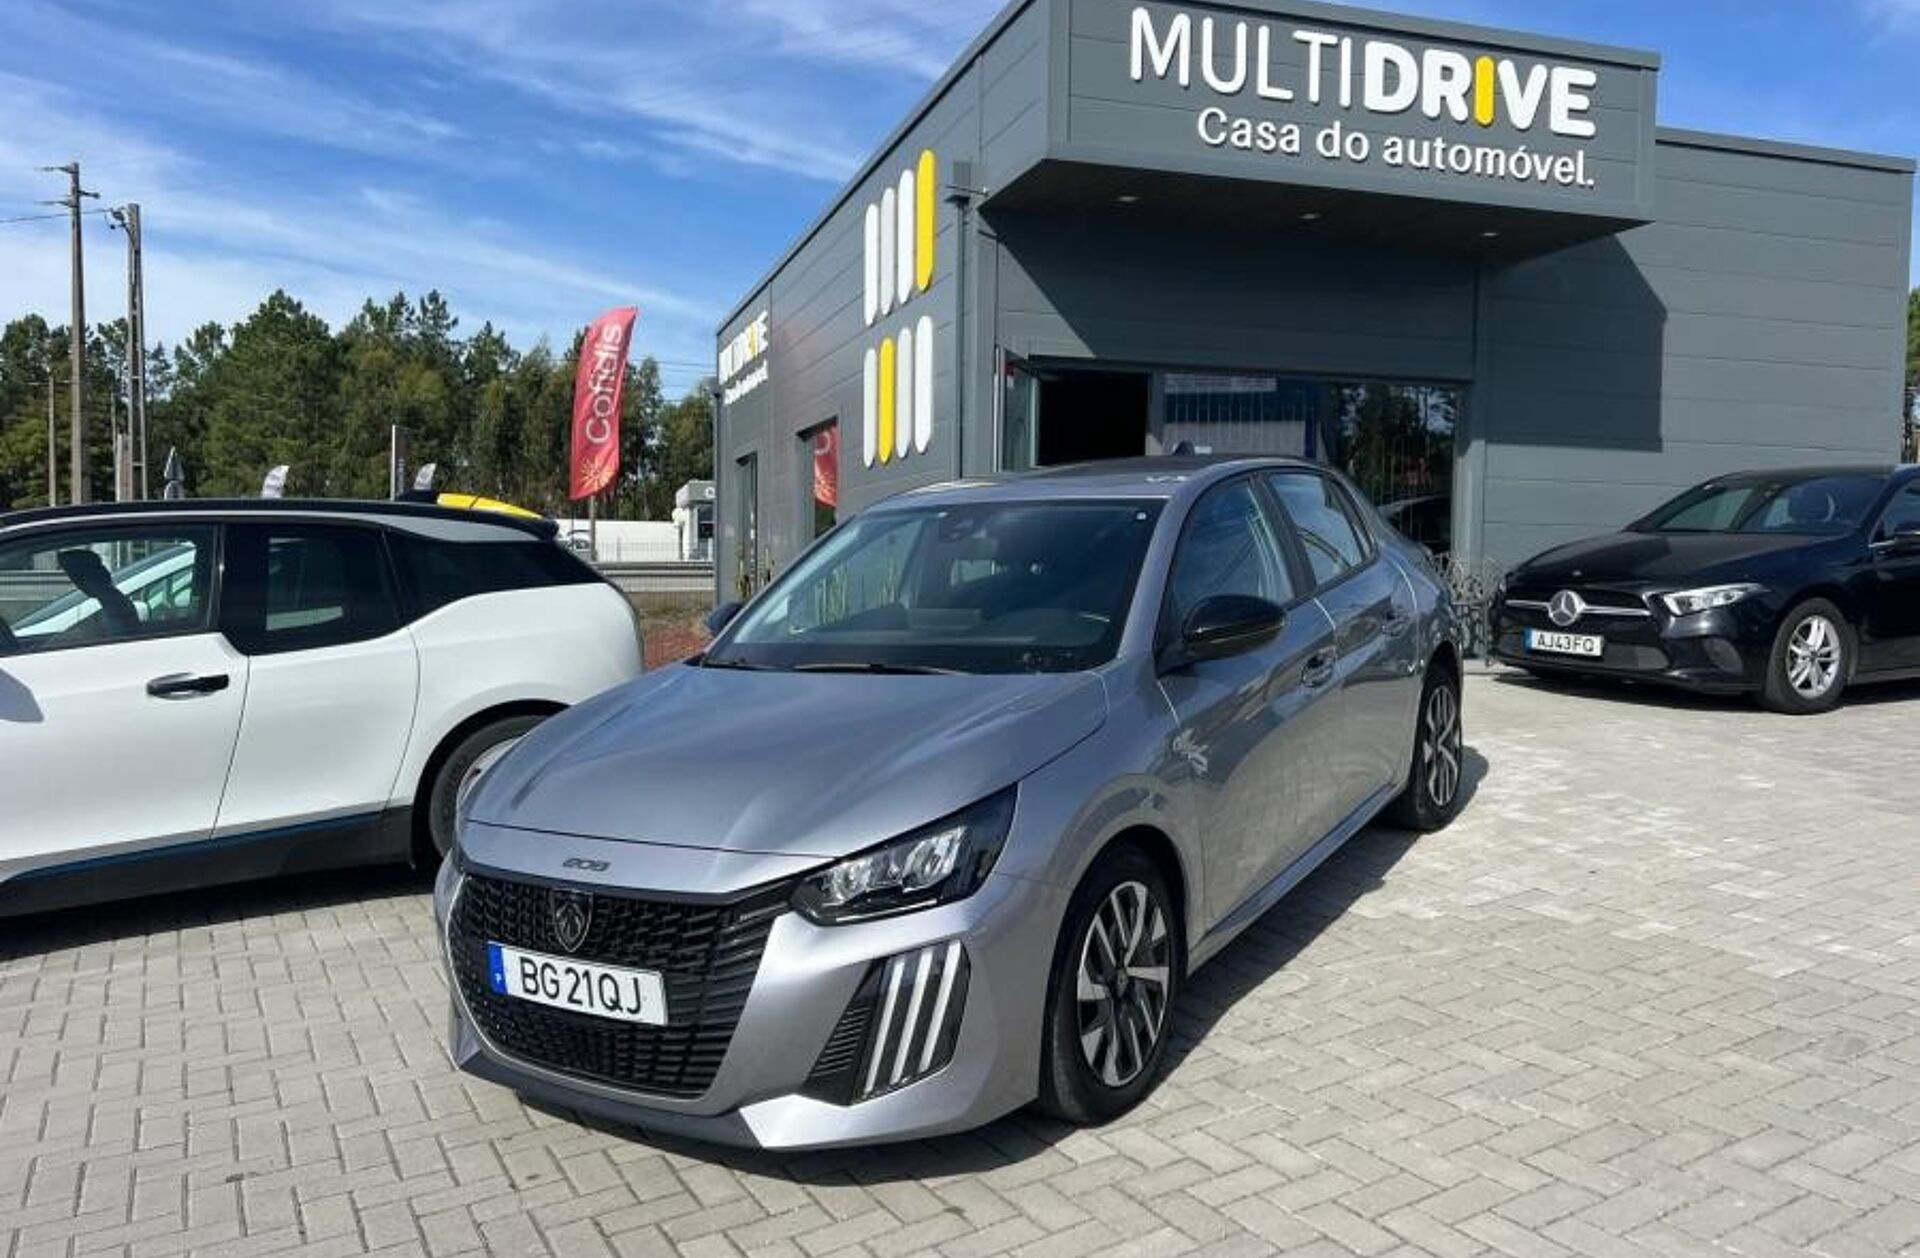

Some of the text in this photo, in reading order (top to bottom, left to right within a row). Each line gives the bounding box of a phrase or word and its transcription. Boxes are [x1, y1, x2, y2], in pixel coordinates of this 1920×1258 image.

[1130, 7, 1597, 138] MULTIDRIVE
[1197, 107, 1595, 188] Casa do automóvel.
